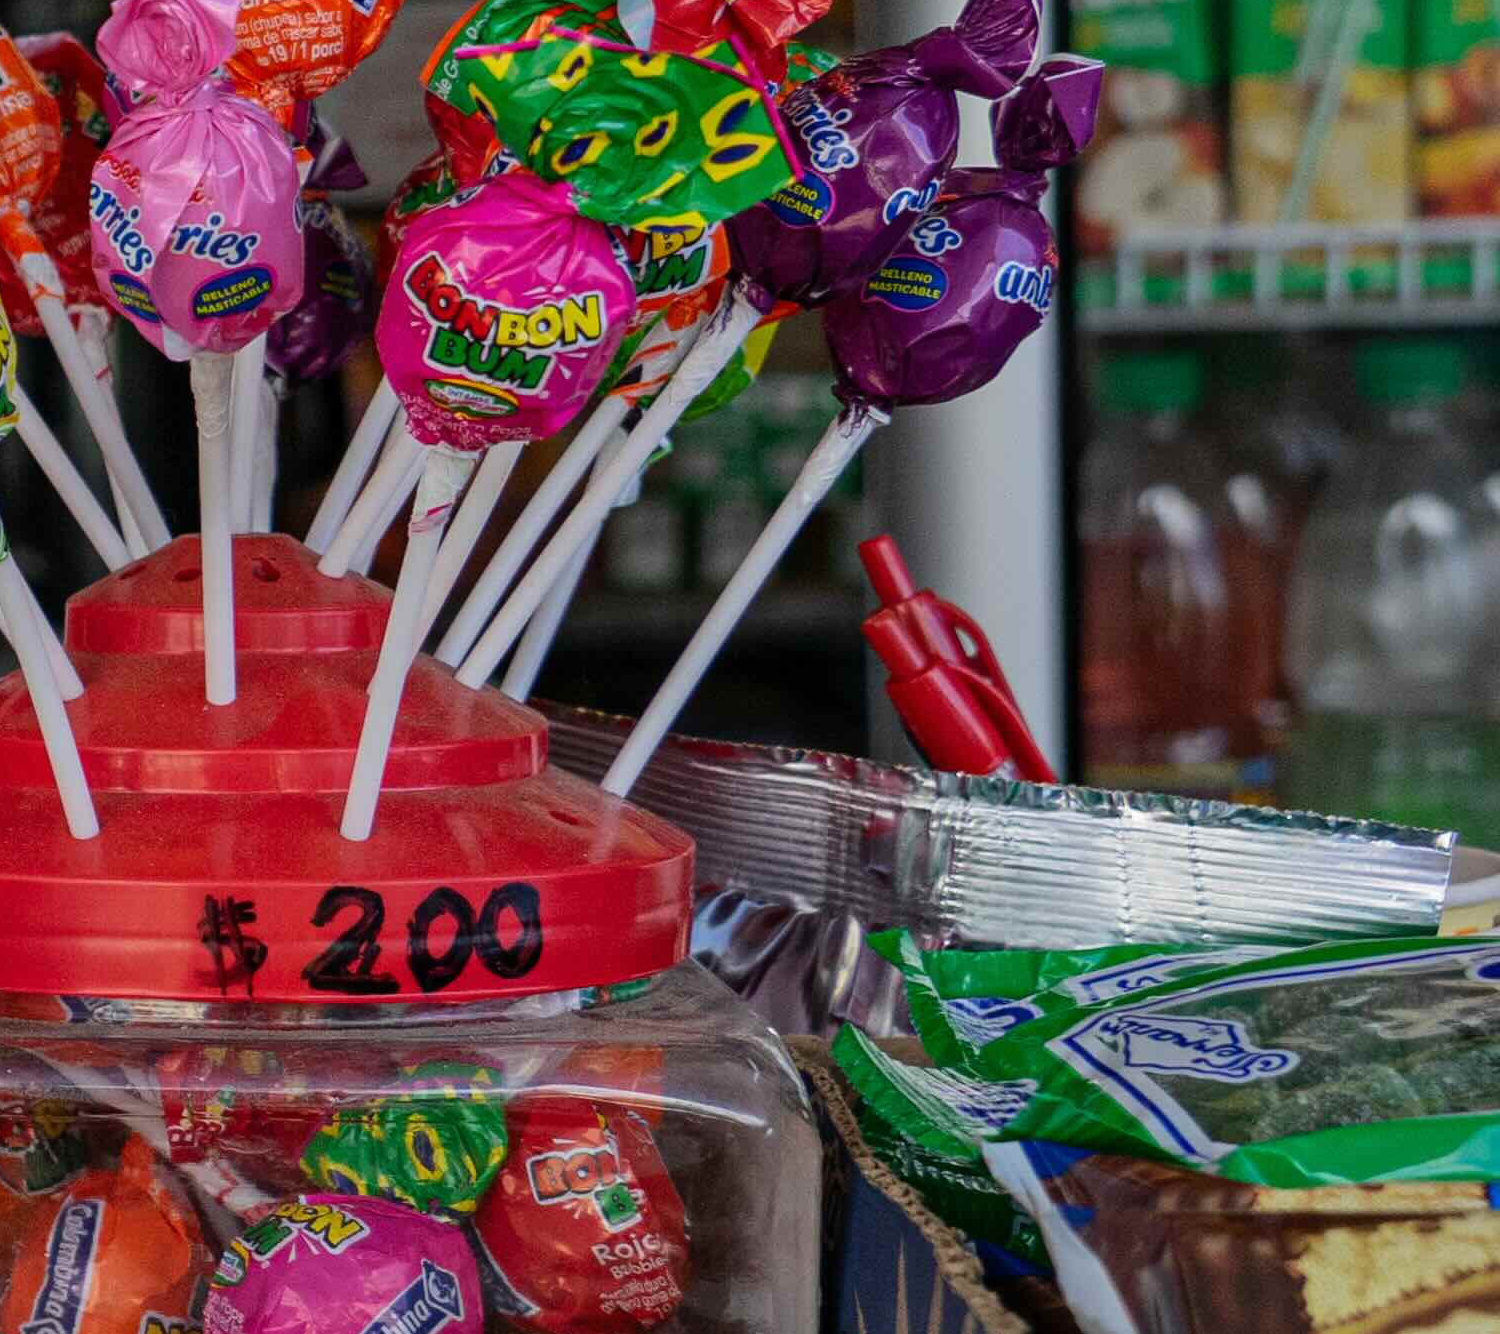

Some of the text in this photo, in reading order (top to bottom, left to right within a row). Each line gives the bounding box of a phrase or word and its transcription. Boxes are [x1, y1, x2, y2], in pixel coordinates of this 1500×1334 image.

[408, 254, 601, 348] BON BON
[867, 280, 941, 300] MASTICABLE
[430, 326, 551, 389] BUM
[300, 881, 544, 994] 200
